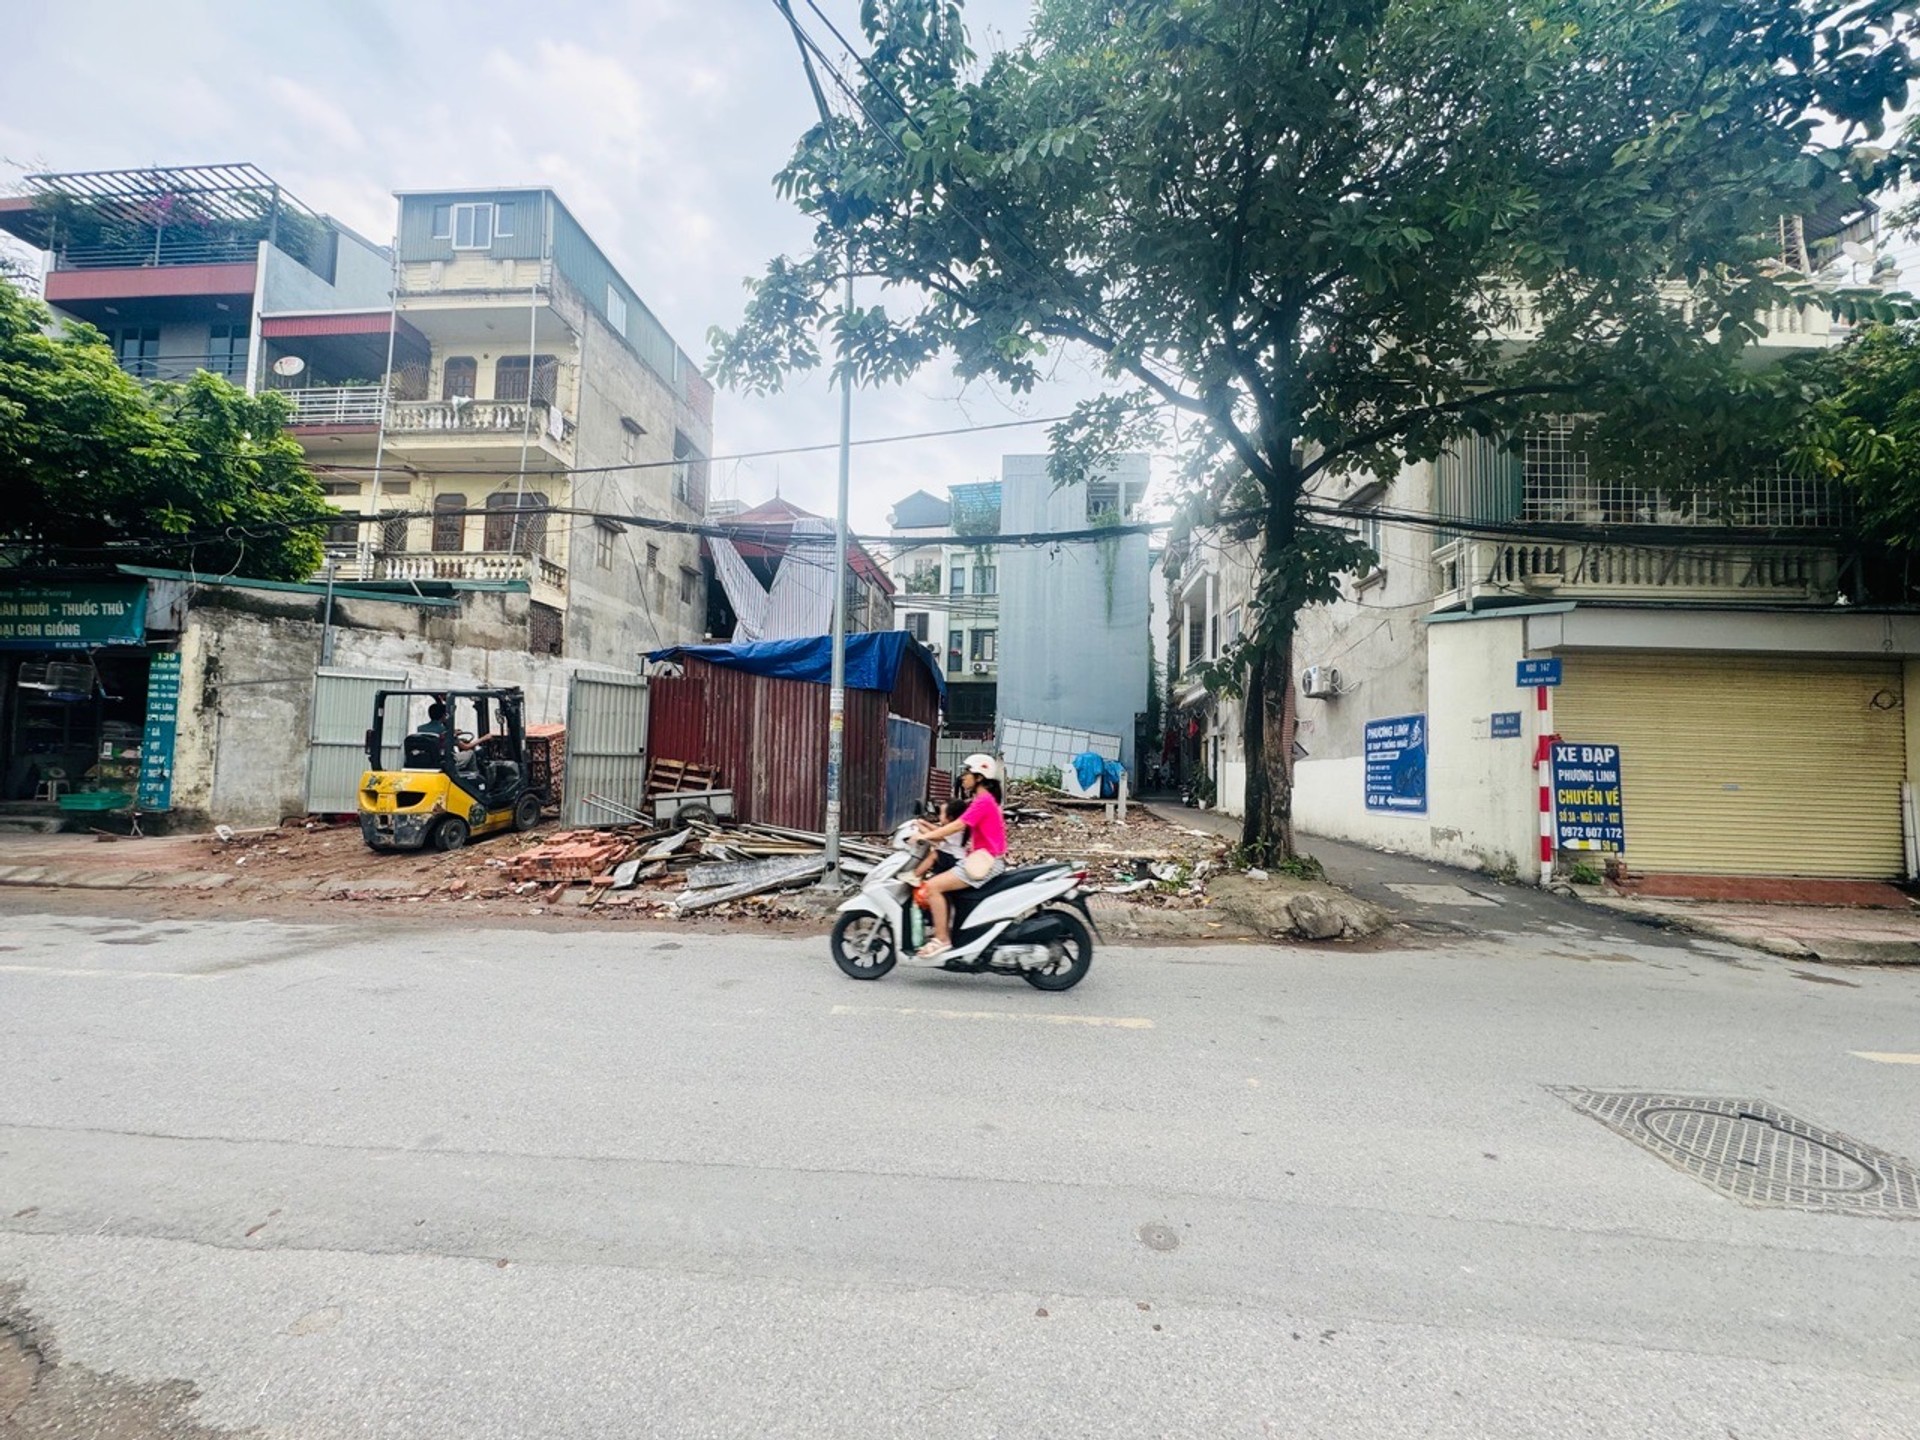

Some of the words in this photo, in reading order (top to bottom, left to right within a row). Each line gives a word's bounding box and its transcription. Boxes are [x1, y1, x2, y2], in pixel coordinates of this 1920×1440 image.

[21, 601, 50, 616] NUÔI
[61, 599, 99, 616] THUỐC
[17, 623, 42, 636] CON
[44, 620, 81, 636] GIỐNG
[157, 652, 177, 661] 139
[1556, 746, 1578, 762] XE
[1581, 747, 1615, 766] ĐẠP
[1558, 769, 1594, 782] PHƯƠNG
[1596, 770, 1617, 782] LINH
[1559, 808, 1567, 822] SỐ
[1561, 826, 1584, 837] 0972
[1605, 828, 1622, 838] 172
